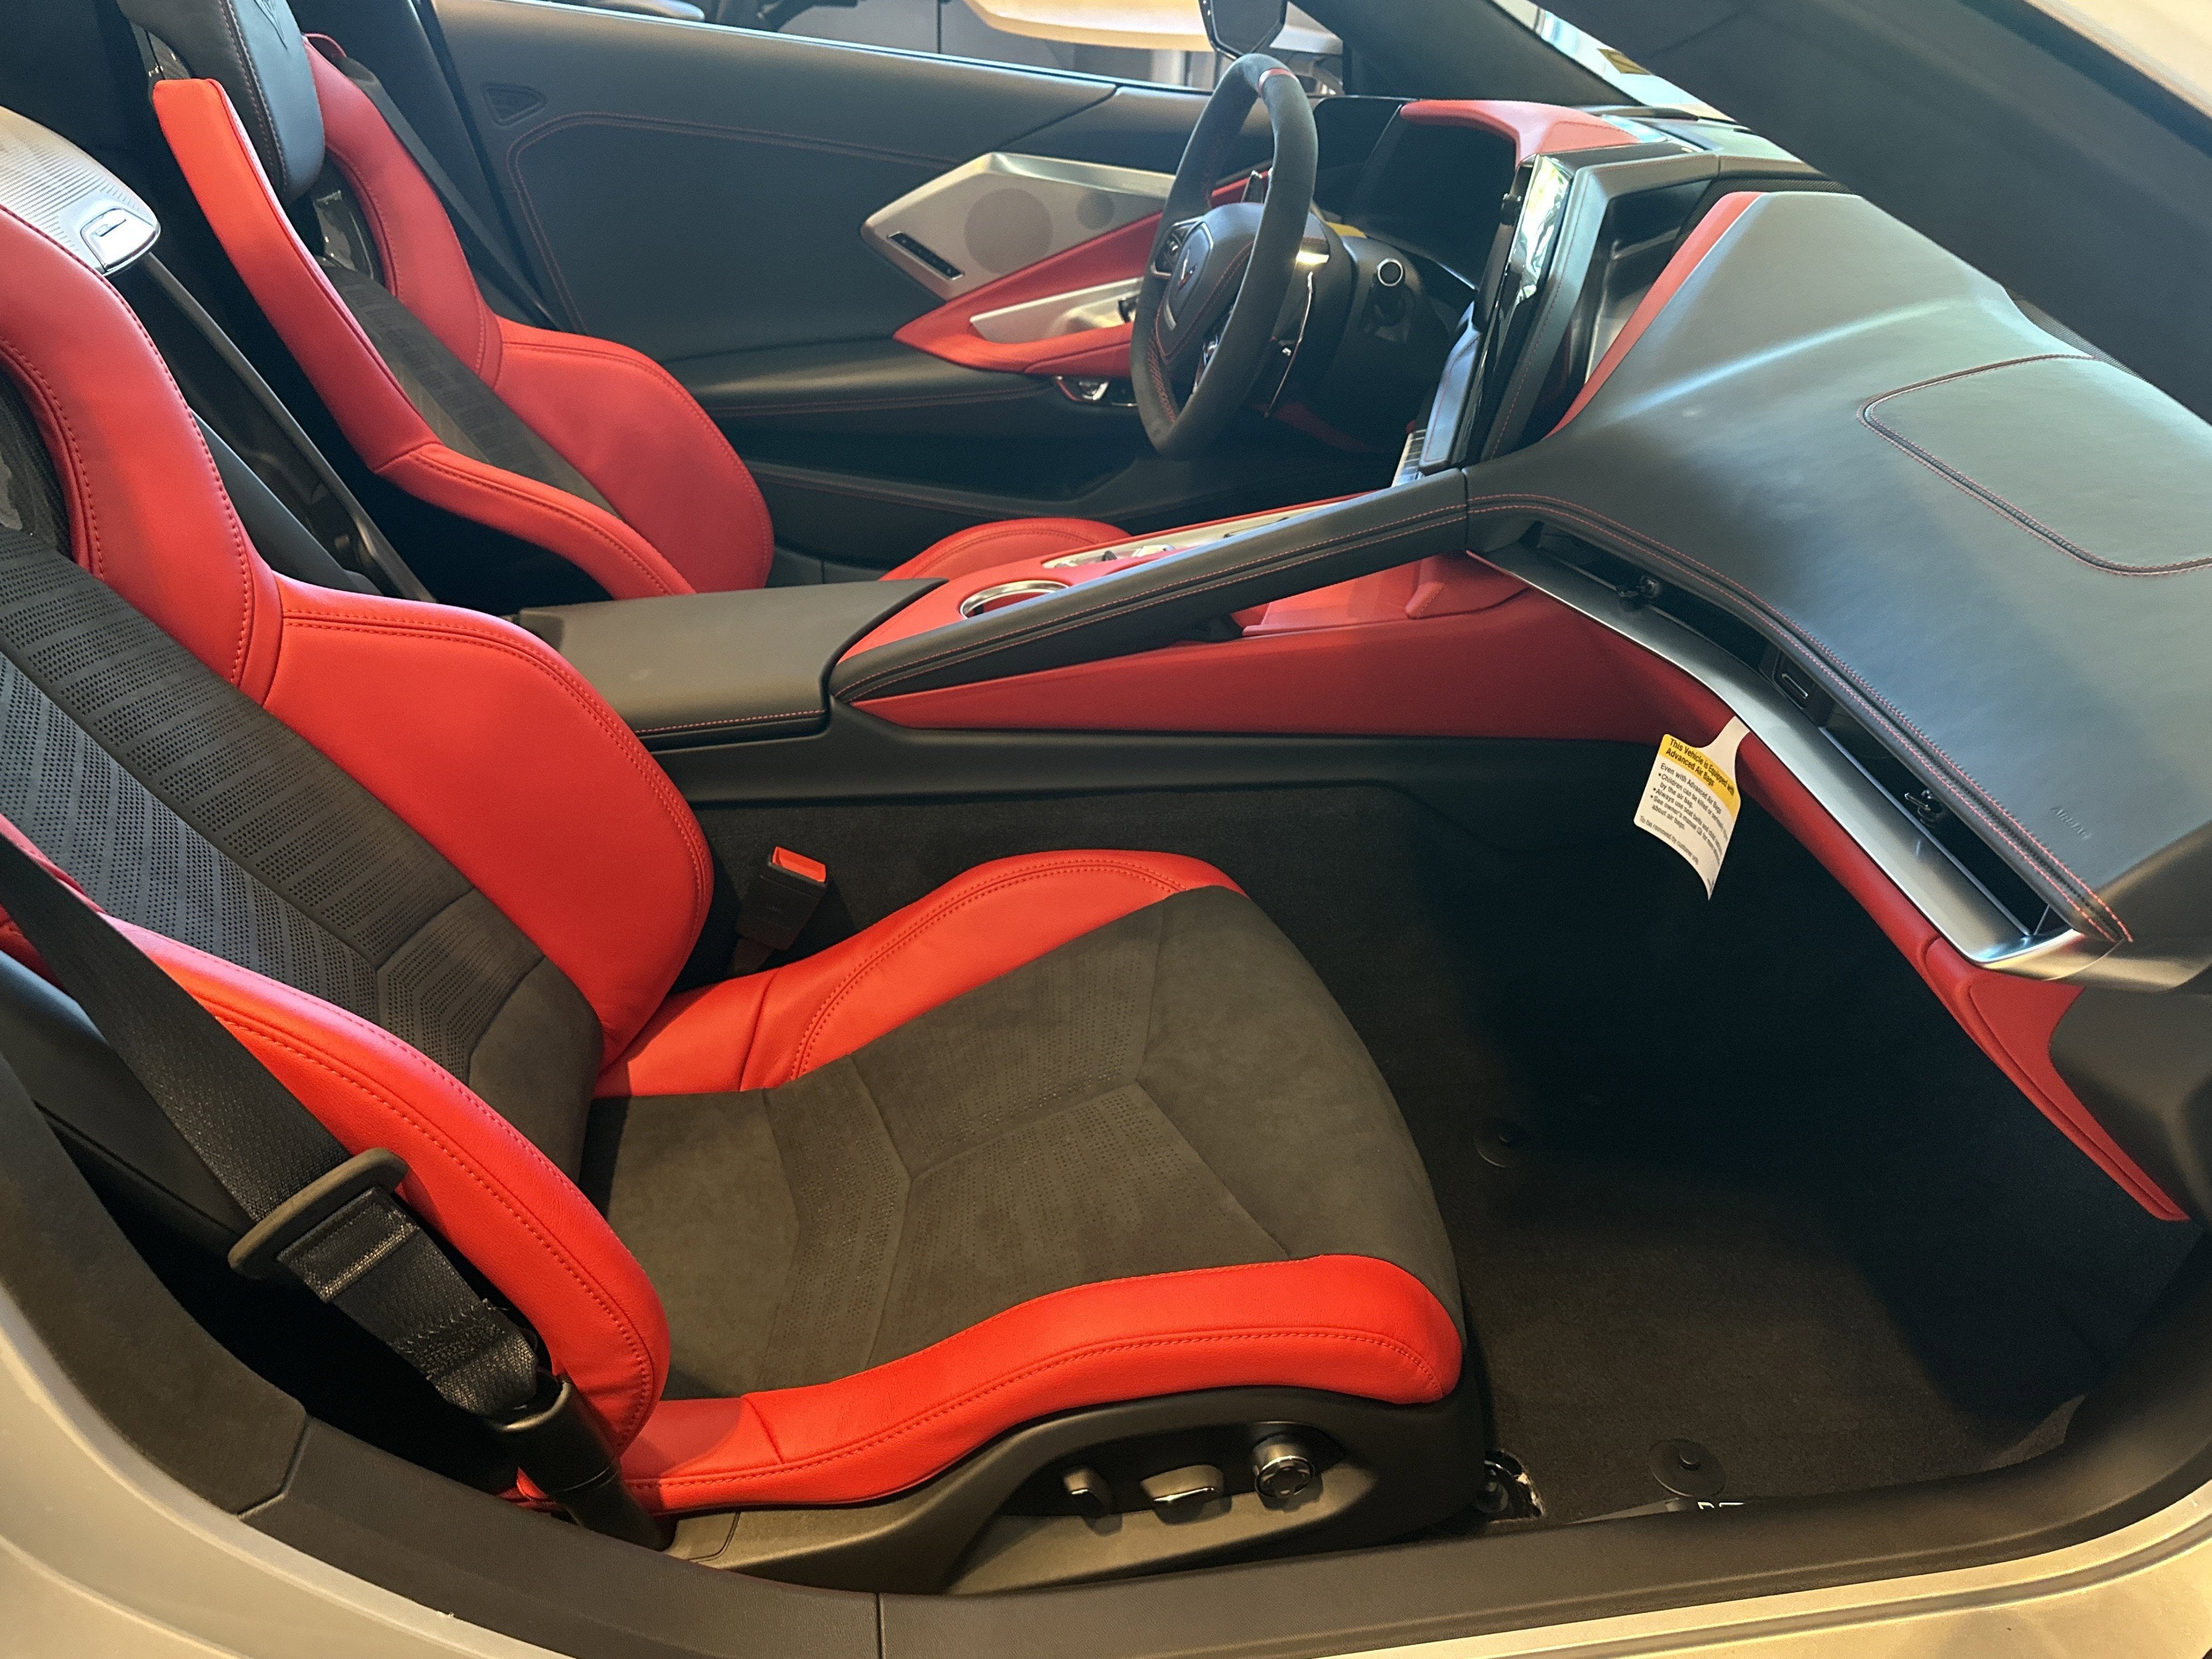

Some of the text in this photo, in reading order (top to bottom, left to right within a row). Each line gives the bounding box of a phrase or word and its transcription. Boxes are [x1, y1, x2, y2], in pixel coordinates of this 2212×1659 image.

[1666, 747, 1695, 770] Advanced
[1703, 771, 1714, 787] Bags
[1670, 738, 1683, 752] This
[1684, 746, 1703, 764] Vehicle
[1703, 760, 1708, 769] is
[1708, 764, 1728, 787] Equipped
[1660, 782, 1667, 790] by
[1668, 786, 1676, 795] the
[1661, 763, 1674, 775] Even
[1675, 772, 1686, 782] with
[1687, 779, 1708, 799] Advanced
[1713, 801, 1721, 814] Bags
[1662, 774, 1683, 790] Children
[1683, 788, 1691, 797] can
[1652, 804, 1667, 816] about
[1654, 795, 1663, 805] See
[1656, 788, 1674, 803] Always
[1675, 801, 1683, 809] use
[1684, 807, 1693, 817] seat
[1652, 824, 1672, 839] removed
